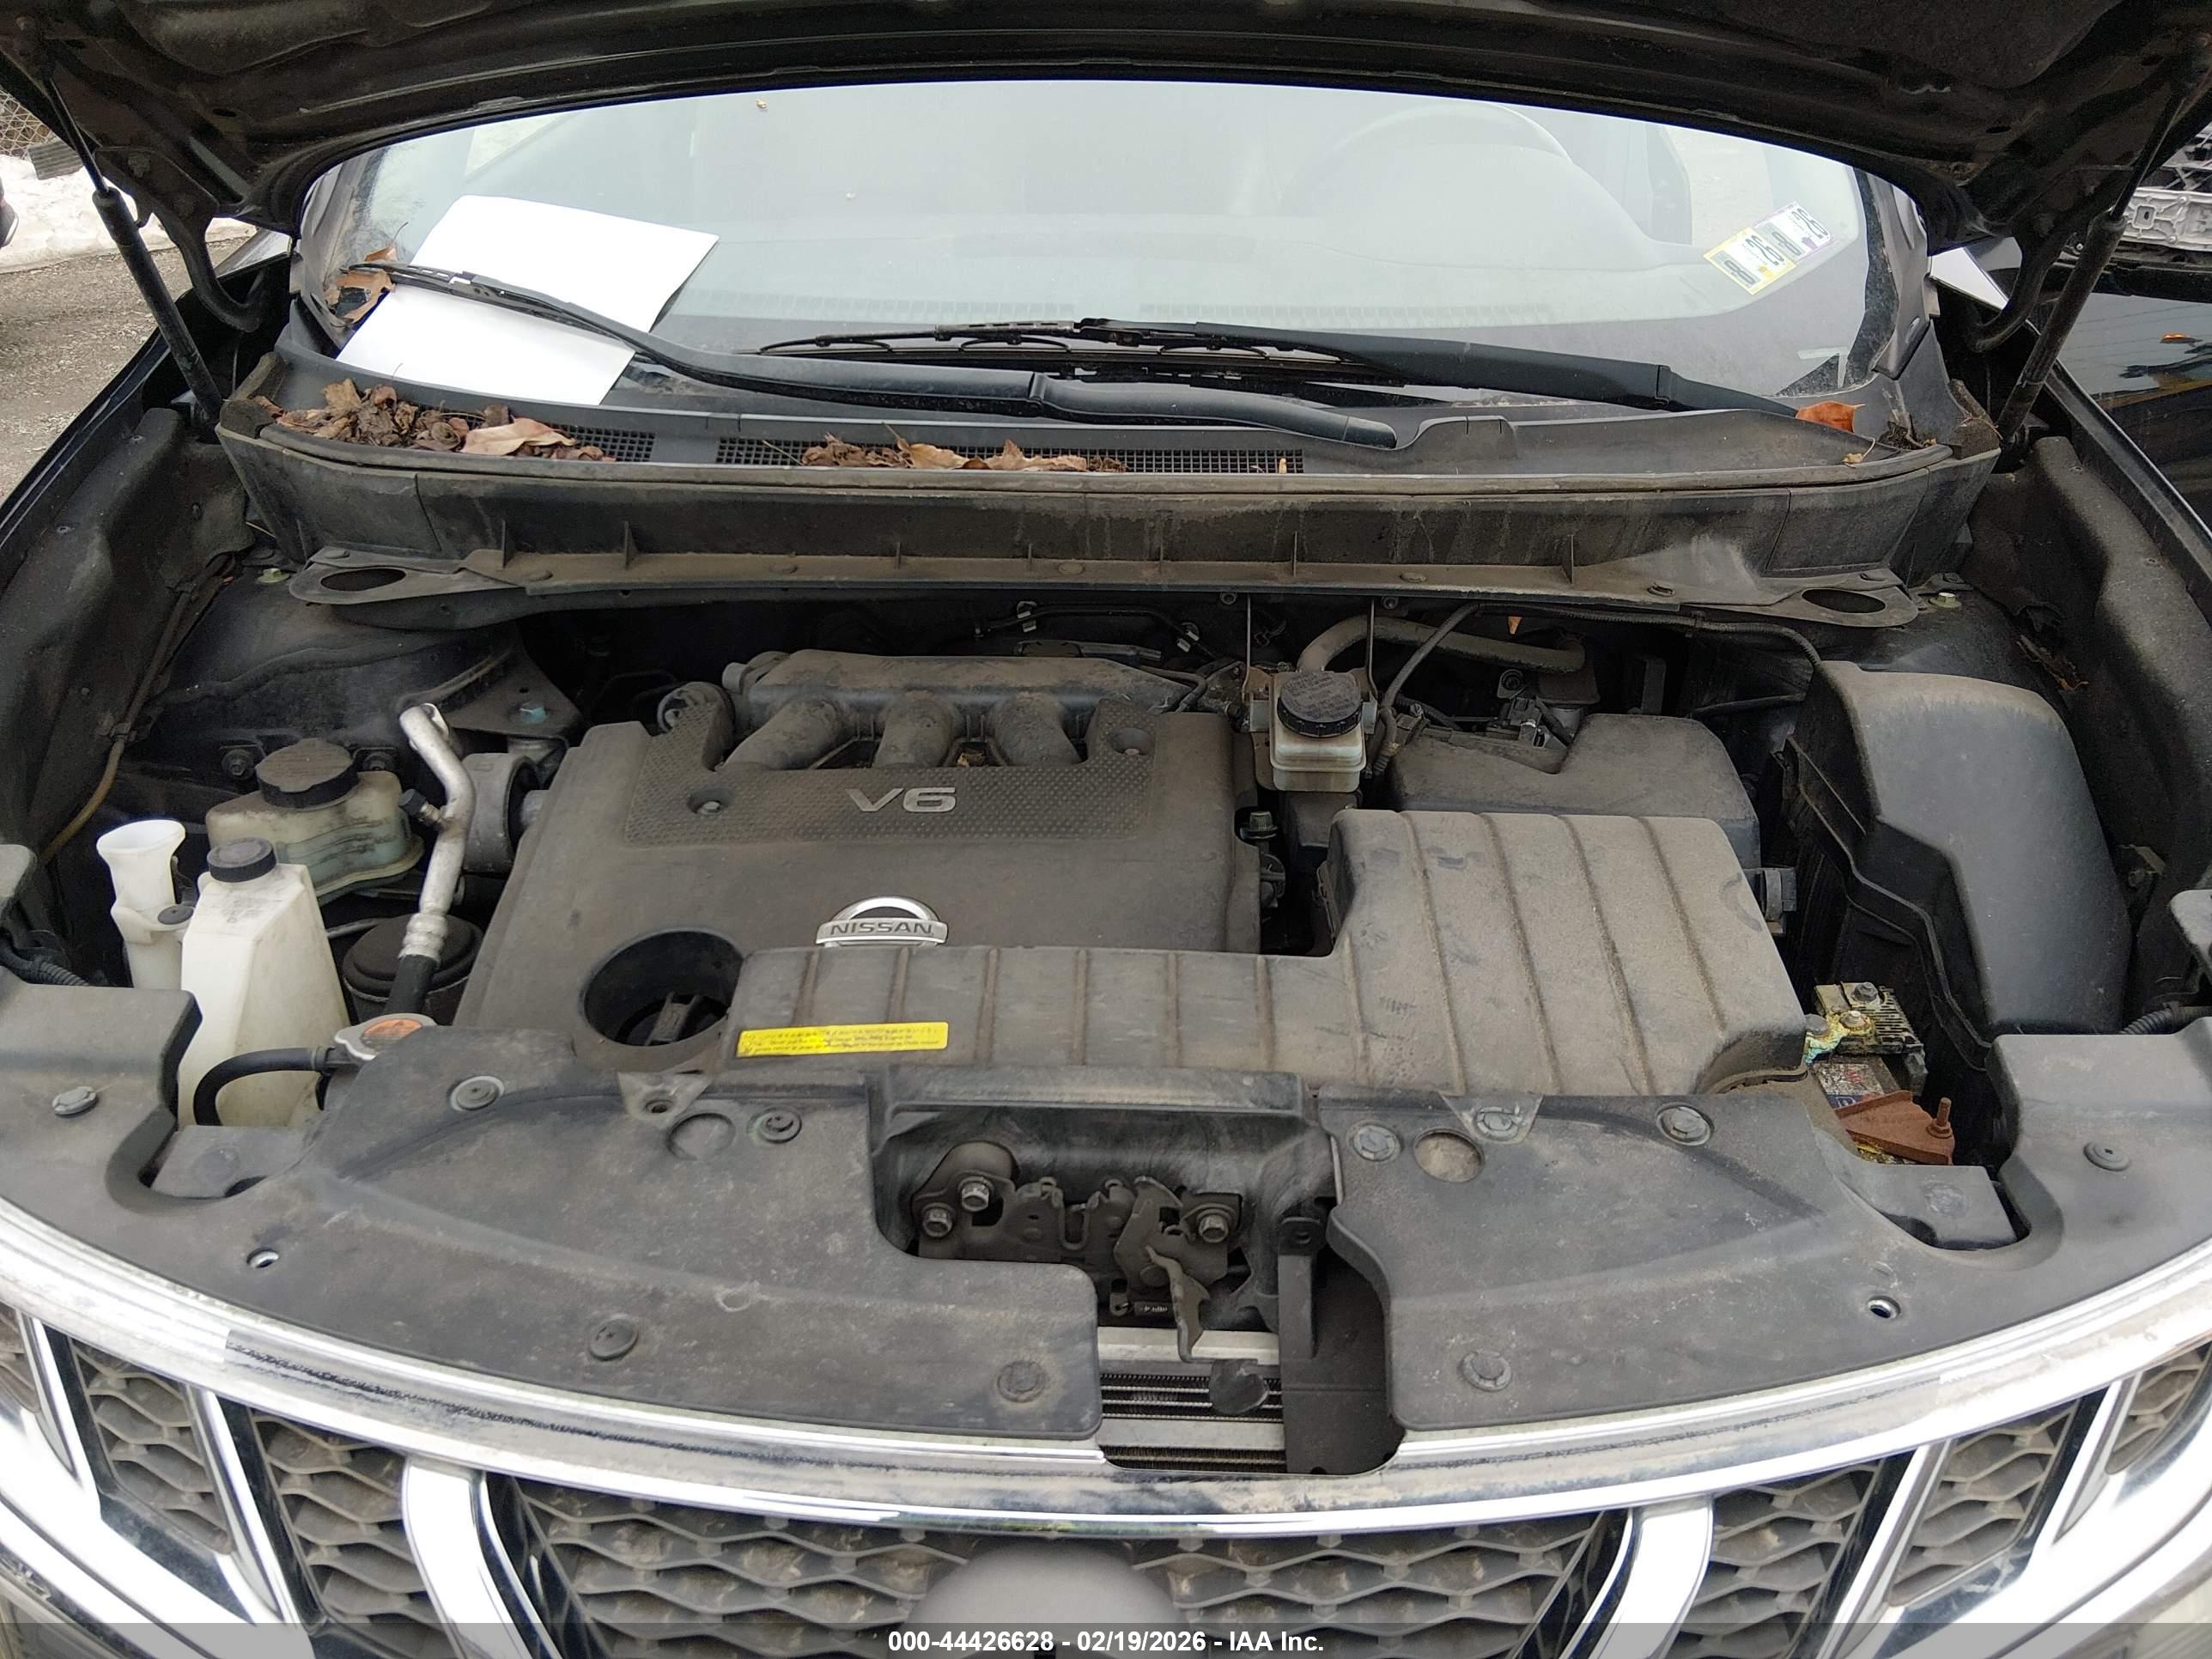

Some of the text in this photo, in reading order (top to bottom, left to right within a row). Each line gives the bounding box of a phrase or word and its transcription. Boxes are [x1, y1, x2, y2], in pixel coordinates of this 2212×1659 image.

[1771, 230, 1802, 257] 8
[1791, 208, 1829, 240] 26
[1723, 259, 1756, 285] 8
[1745, 234, 1785, 266] 26
[844, 787, 957, 813] V6
[830, 921, 933, 936] NISSAN
